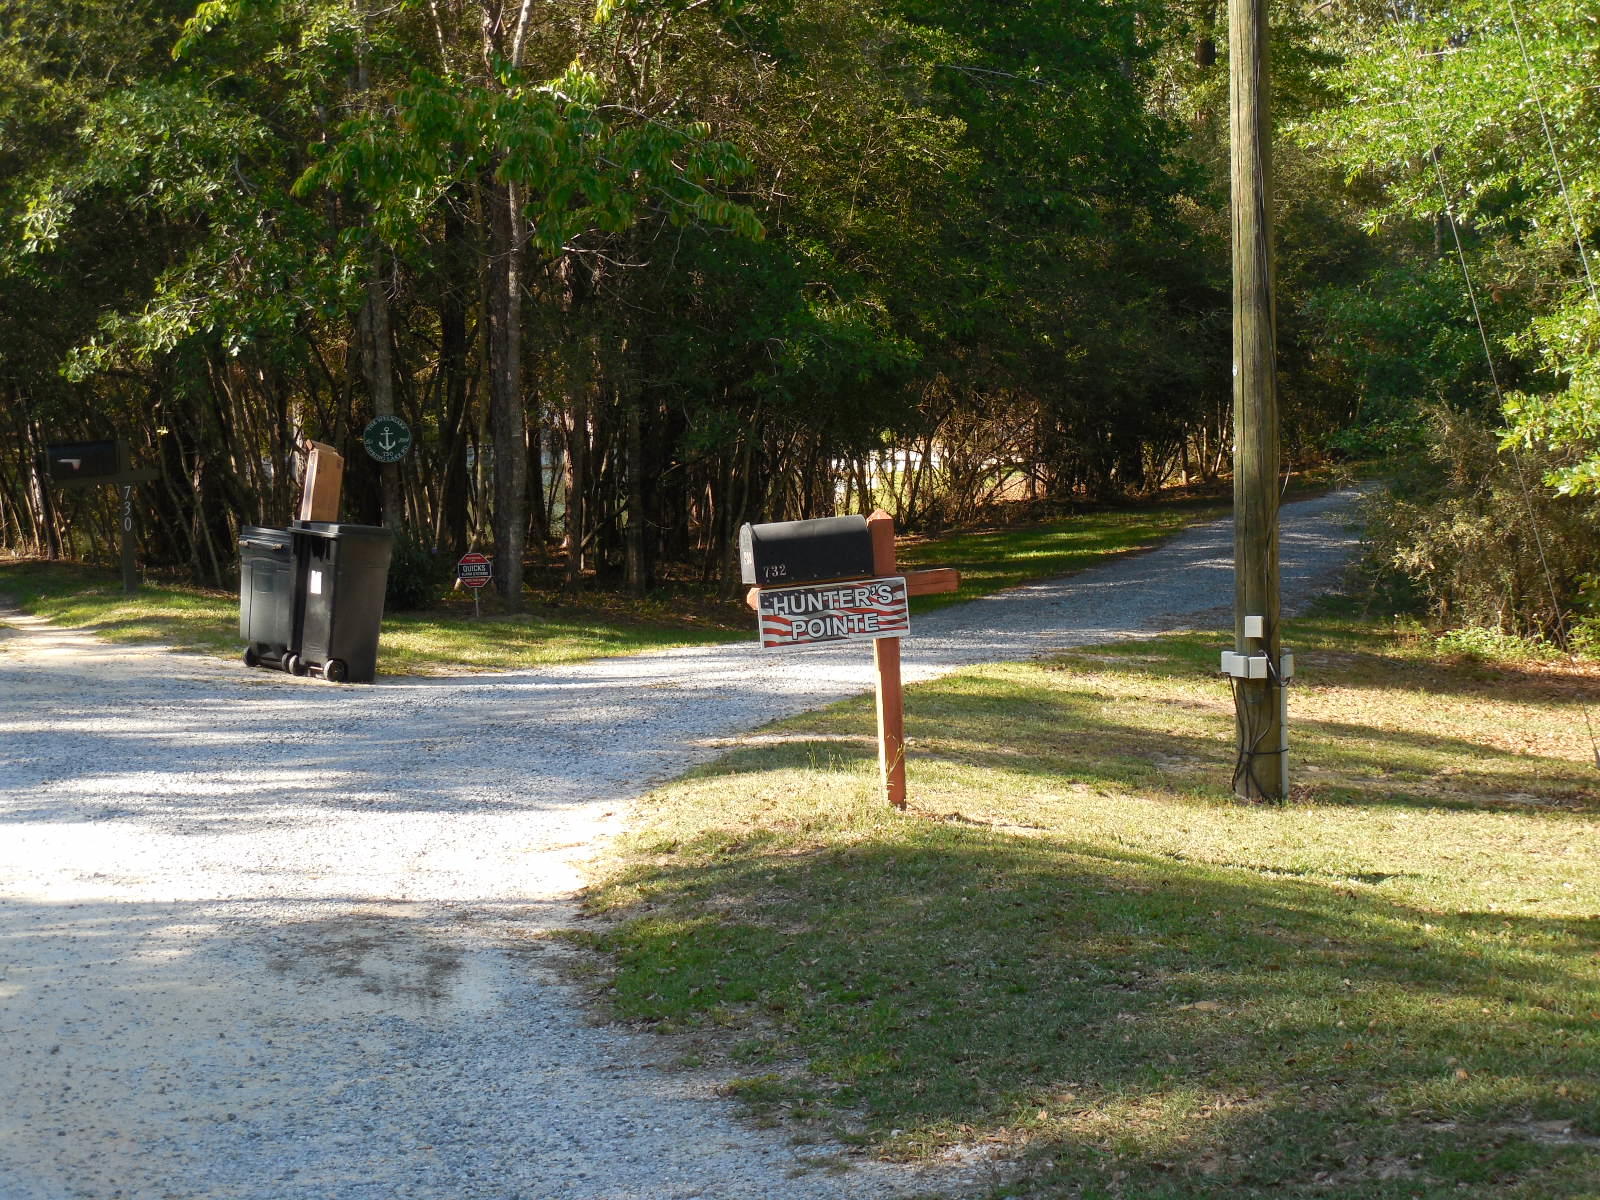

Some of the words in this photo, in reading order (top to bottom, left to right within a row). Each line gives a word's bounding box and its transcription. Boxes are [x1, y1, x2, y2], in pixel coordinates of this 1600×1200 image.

[124, 486, 132, 532] 730
[763, 564, 787, 578] 732
[772, 583, 894, 616] HUNTER'S
[791, 612, 881, 641] POINTE
